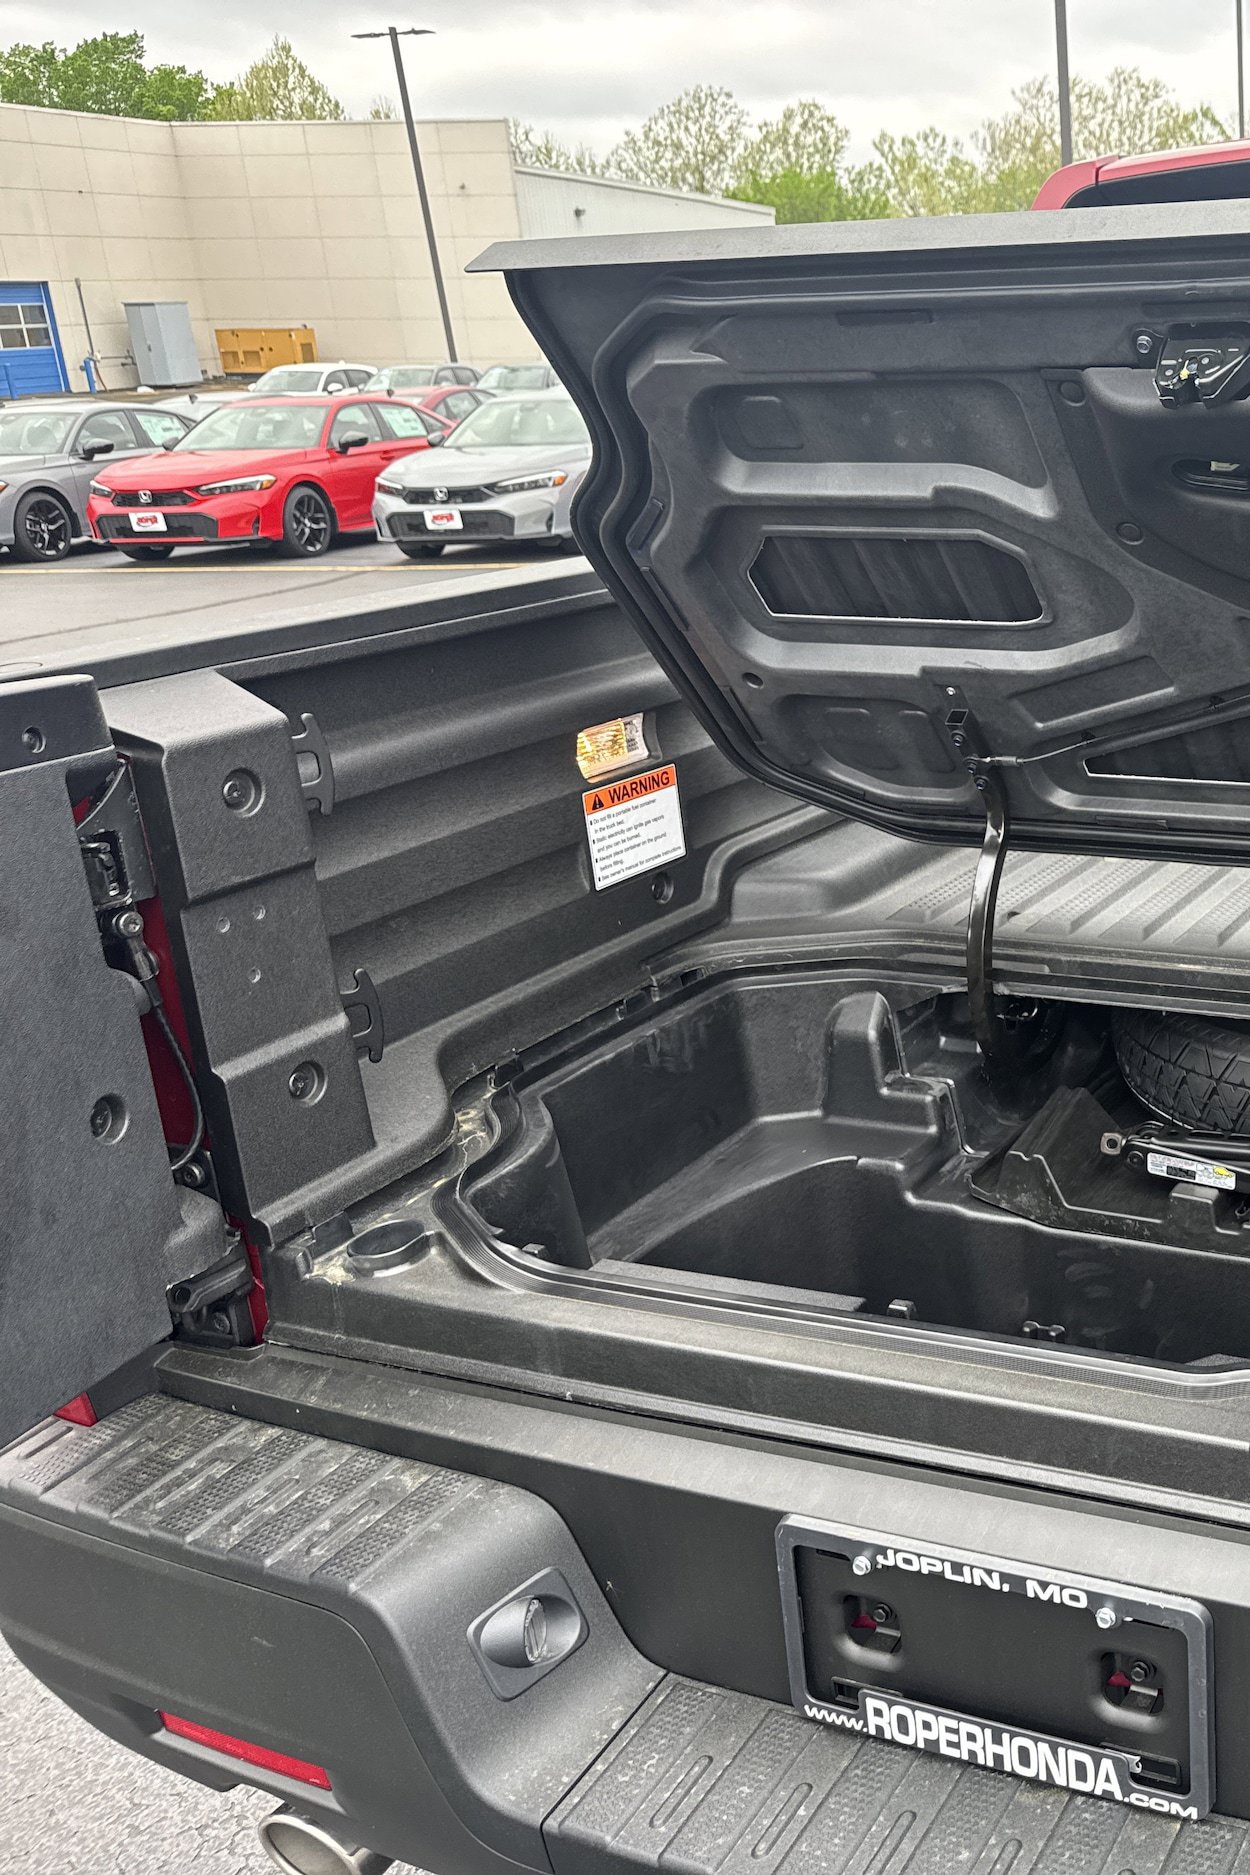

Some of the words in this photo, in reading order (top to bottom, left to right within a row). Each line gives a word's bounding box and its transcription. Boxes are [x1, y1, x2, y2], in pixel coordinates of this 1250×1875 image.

[608, 770, 670, 804] WARNING
[876, 1549, 1010, 1592] JOPLIN,
[1025, 1580, 1088, 1609] MO
